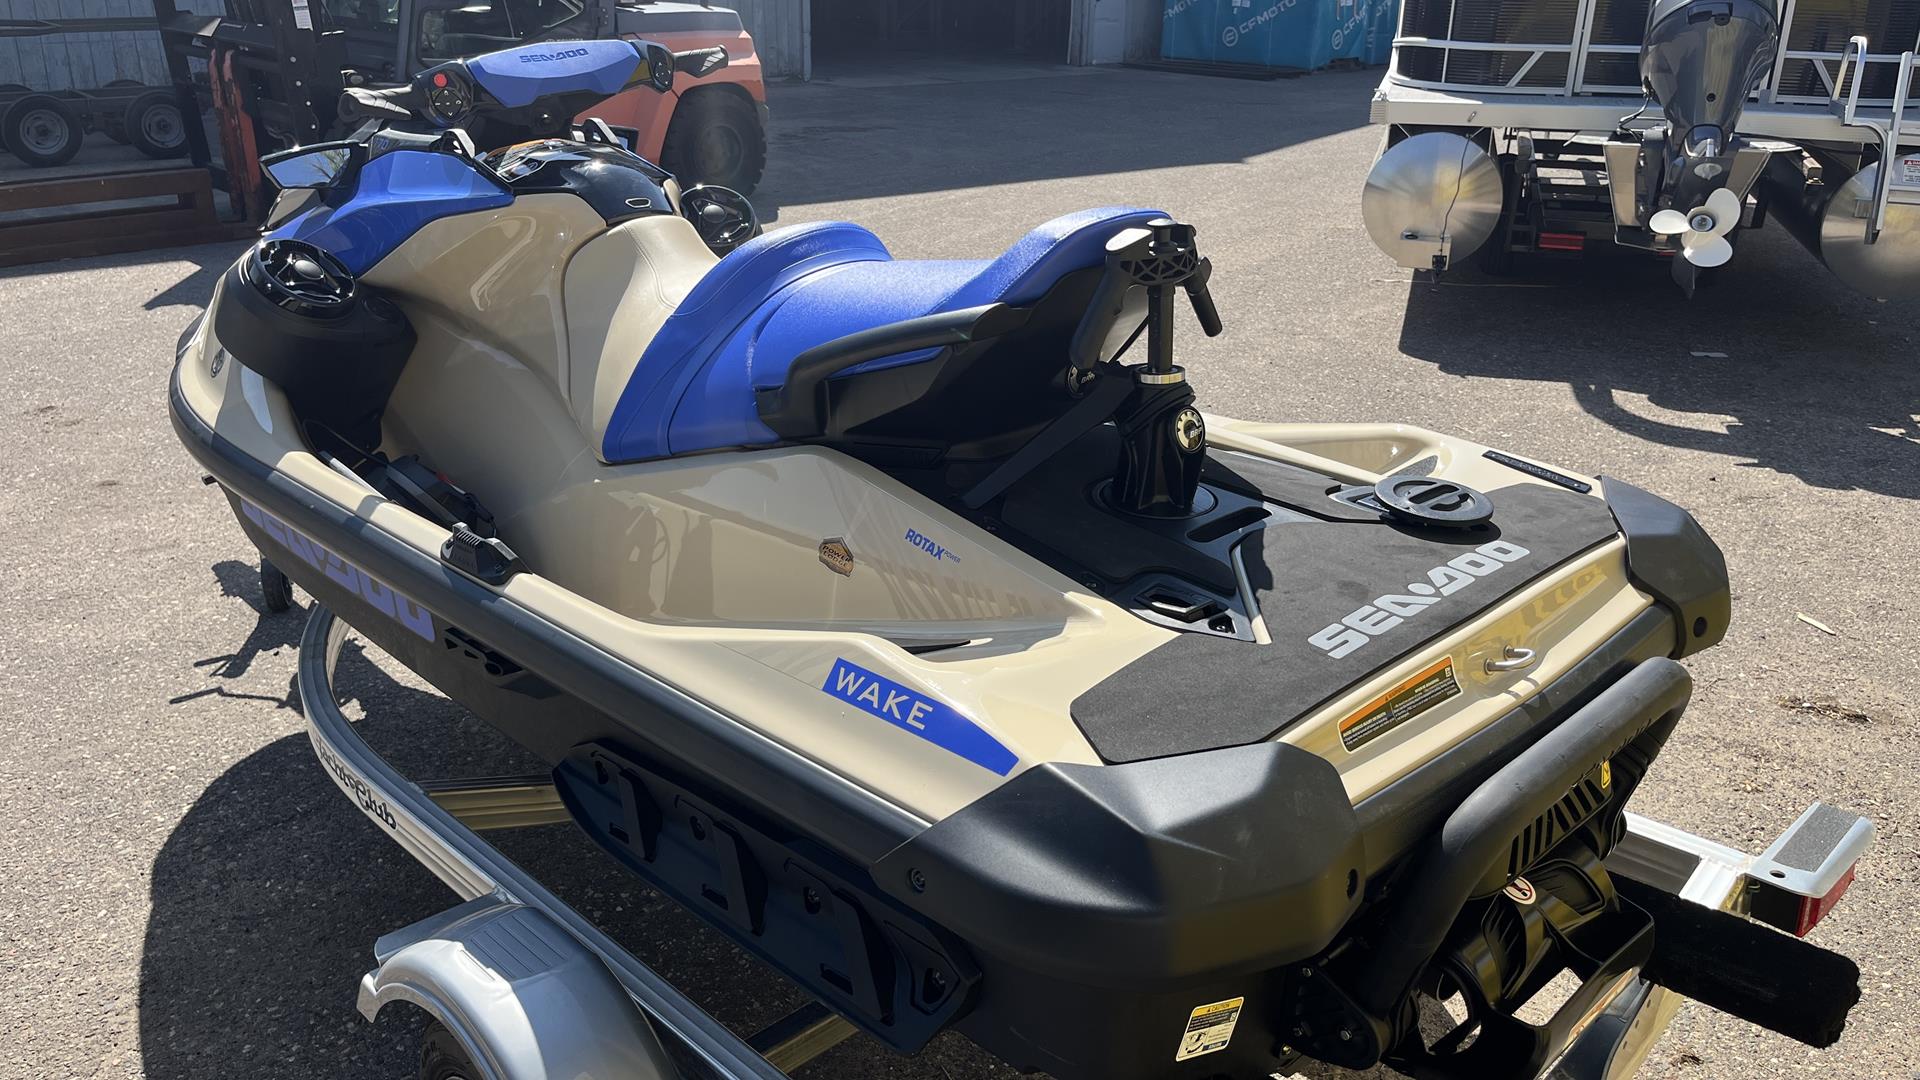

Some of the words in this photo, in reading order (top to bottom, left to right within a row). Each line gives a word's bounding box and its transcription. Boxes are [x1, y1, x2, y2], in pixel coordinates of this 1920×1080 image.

[1239, 0, 1297, 34] CFMOTO
[905, 528, 945, 560] ROTAX
[836, 666, 933, 731] WAKE
